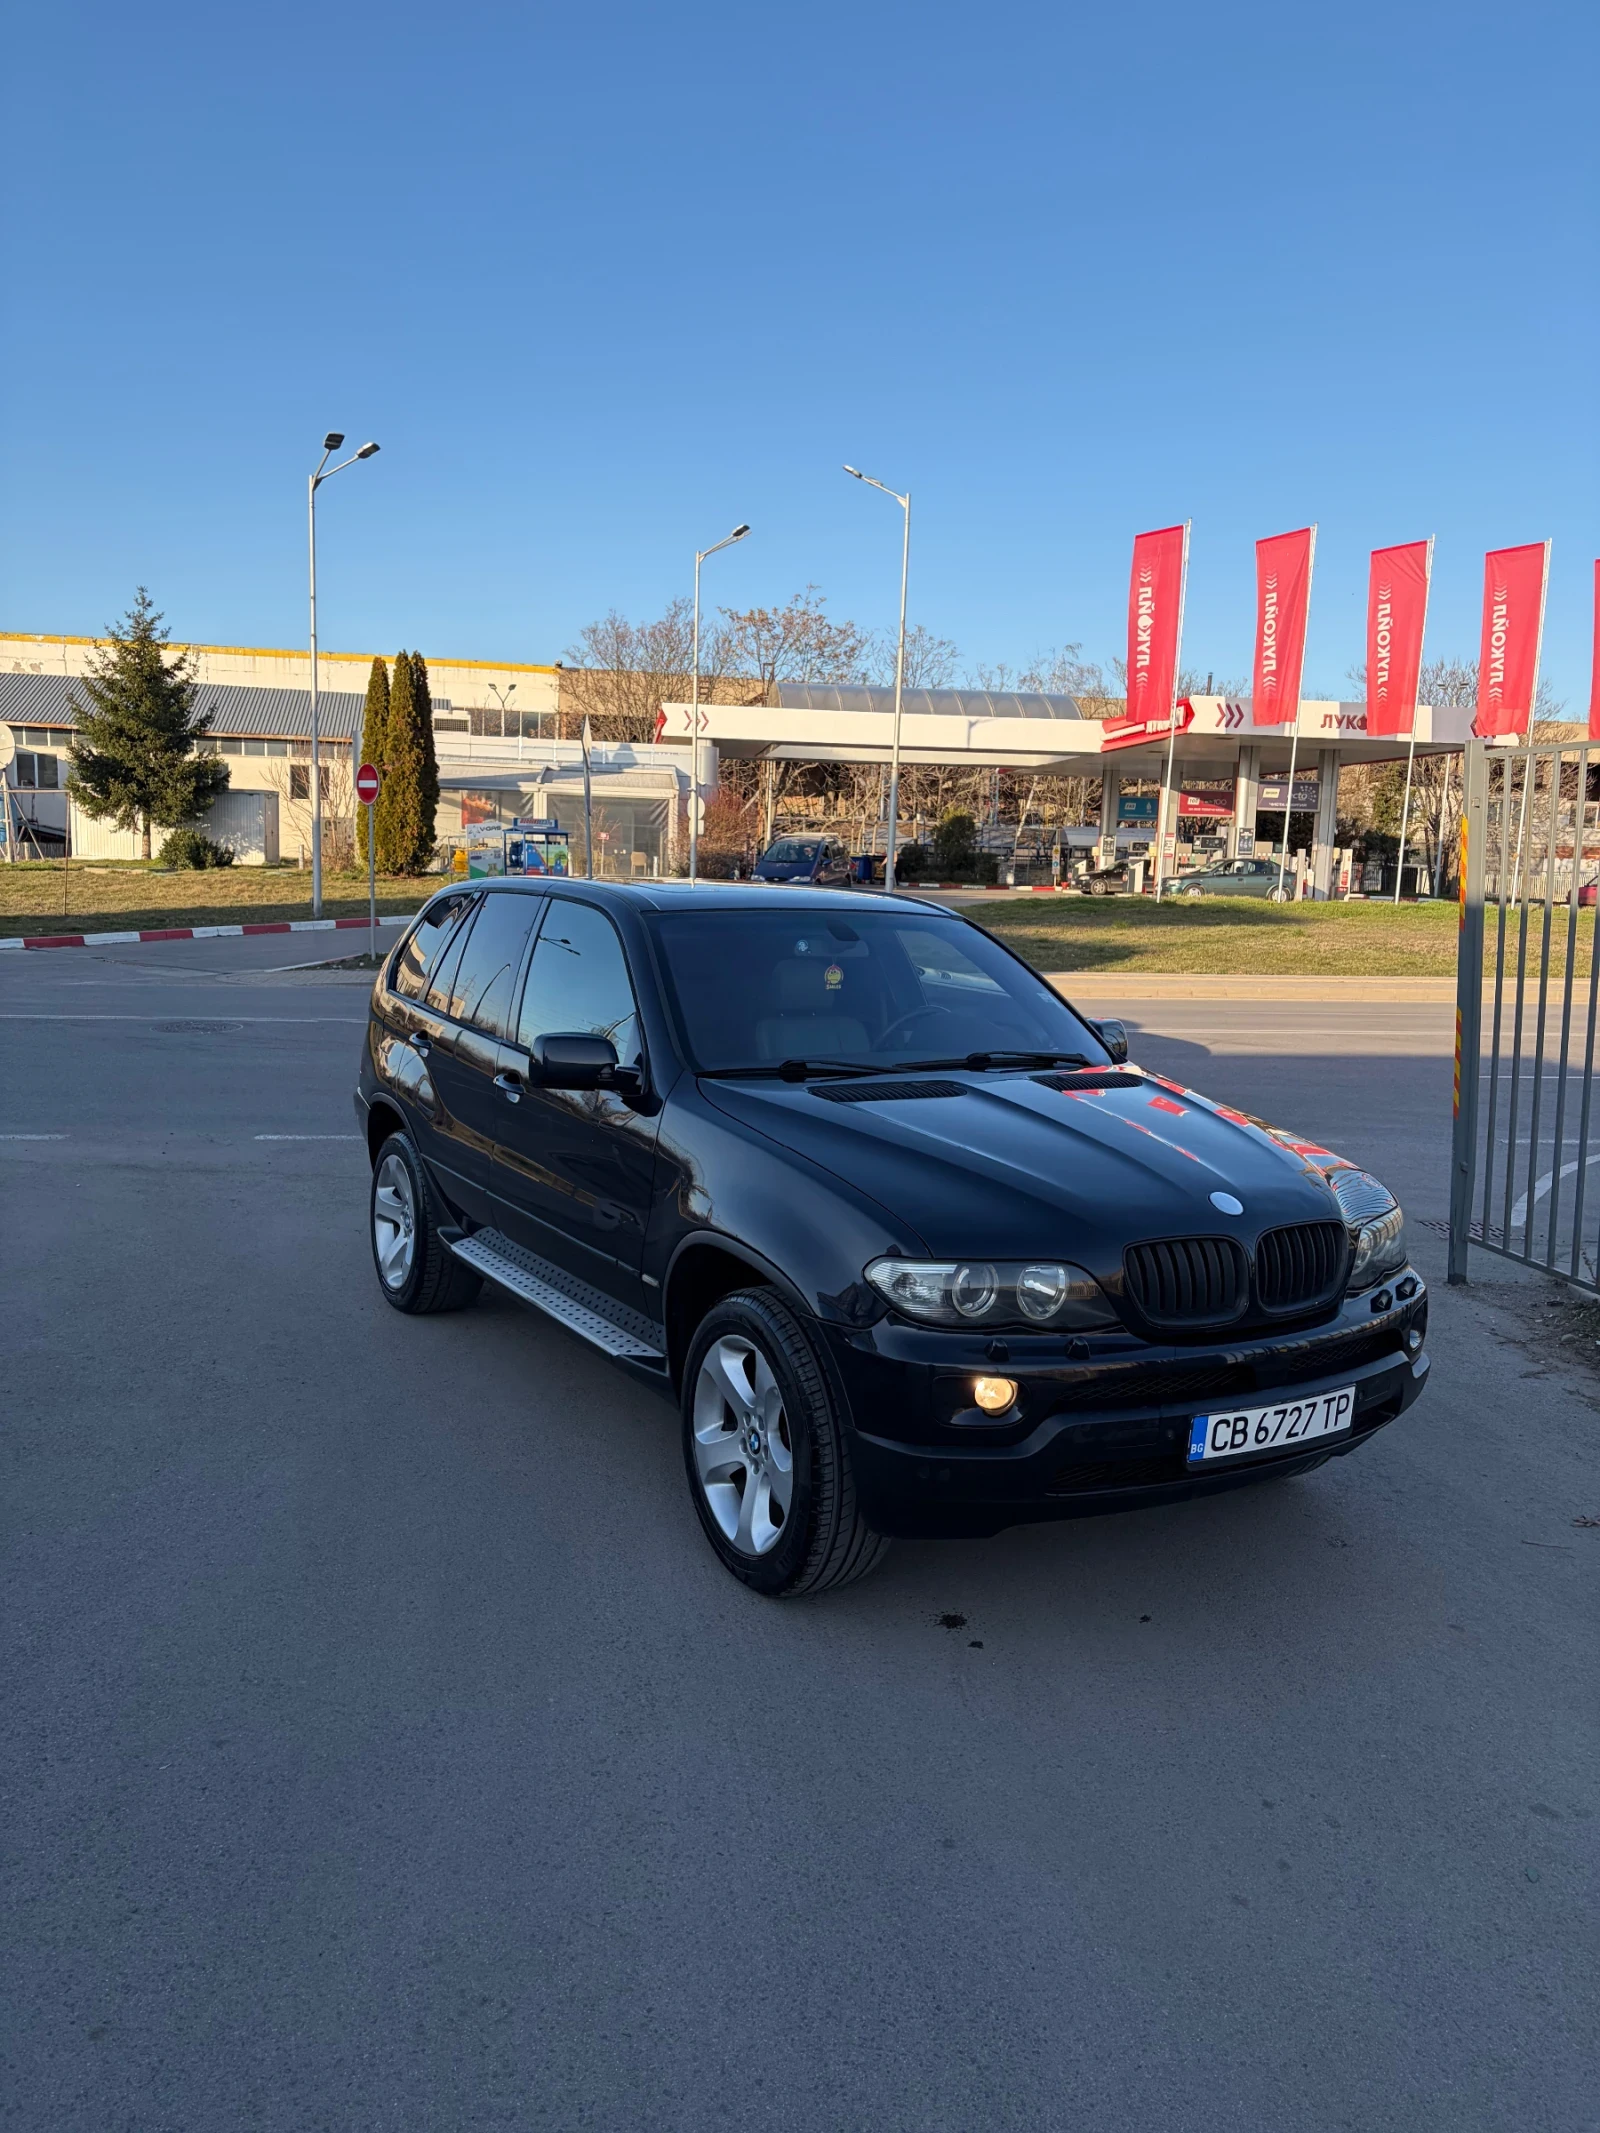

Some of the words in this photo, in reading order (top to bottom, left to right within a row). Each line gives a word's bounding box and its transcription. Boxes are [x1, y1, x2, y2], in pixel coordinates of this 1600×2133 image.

[1320, 712, 1367, 731] ЛУКО
[1211, 1416, 1249, 1452] CB
[1254, 1401, 1318, 1444] 6727
[1322, 1393, 1350, 1429] TP
[1190, 1443, 1204, 1454] BG
